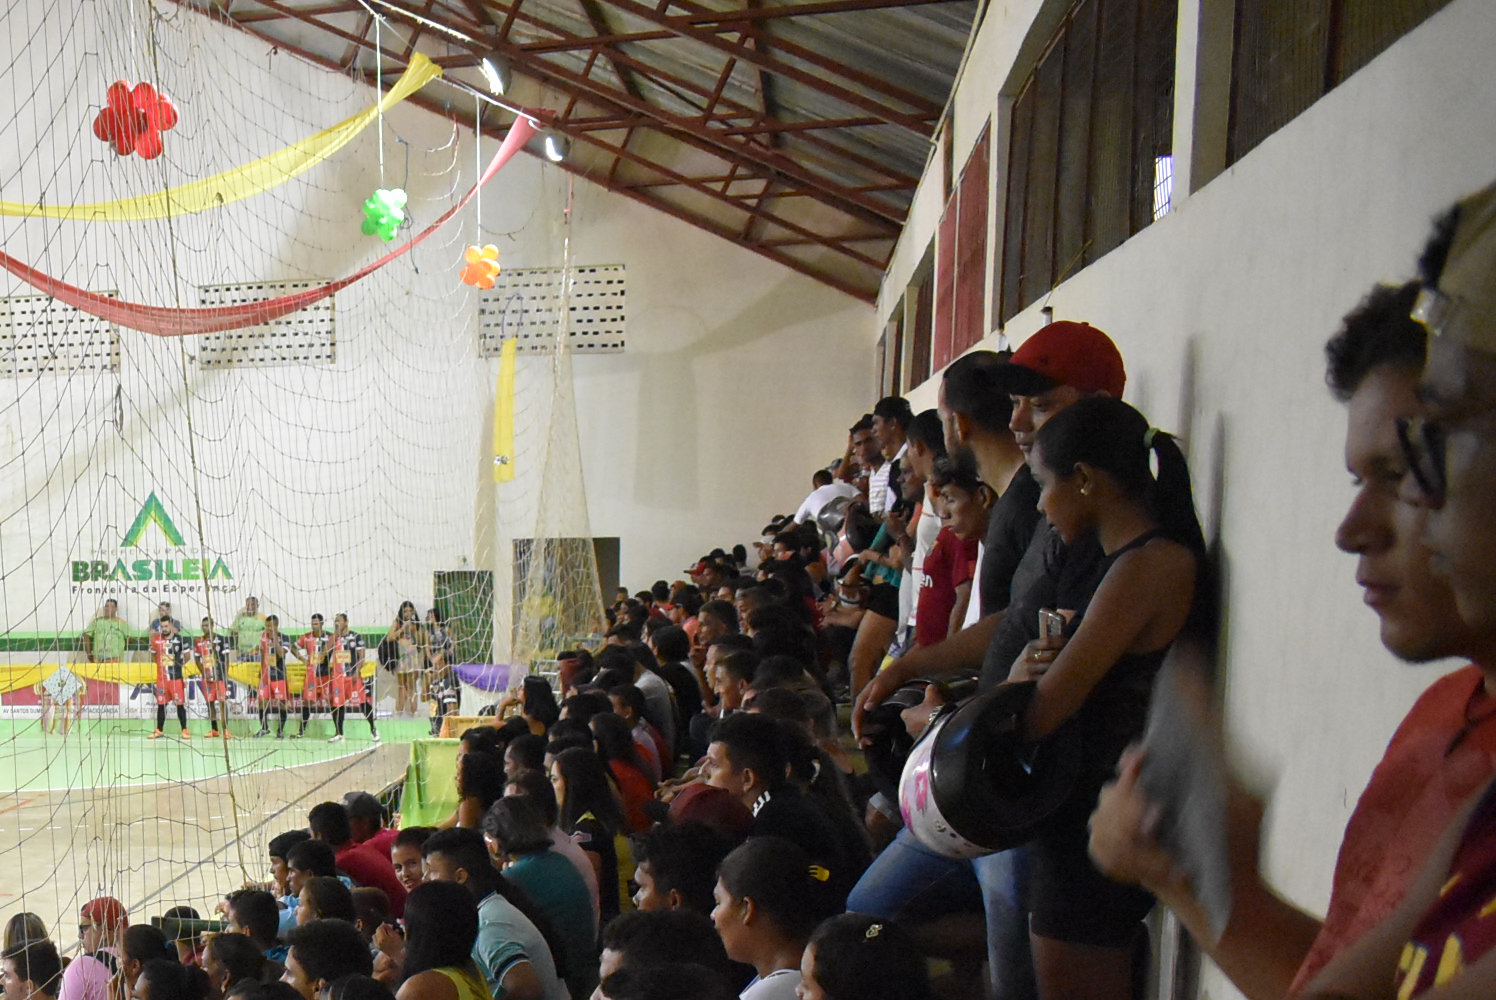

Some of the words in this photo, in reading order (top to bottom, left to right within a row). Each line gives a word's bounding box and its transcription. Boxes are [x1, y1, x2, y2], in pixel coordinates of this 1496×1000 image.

[71, 556, 234, 582] BRASILEIA
[72, 585, 137, 594] Fronteira
[143, 585, 157, 594] da
[163, 584, 237, 595] Espernça
